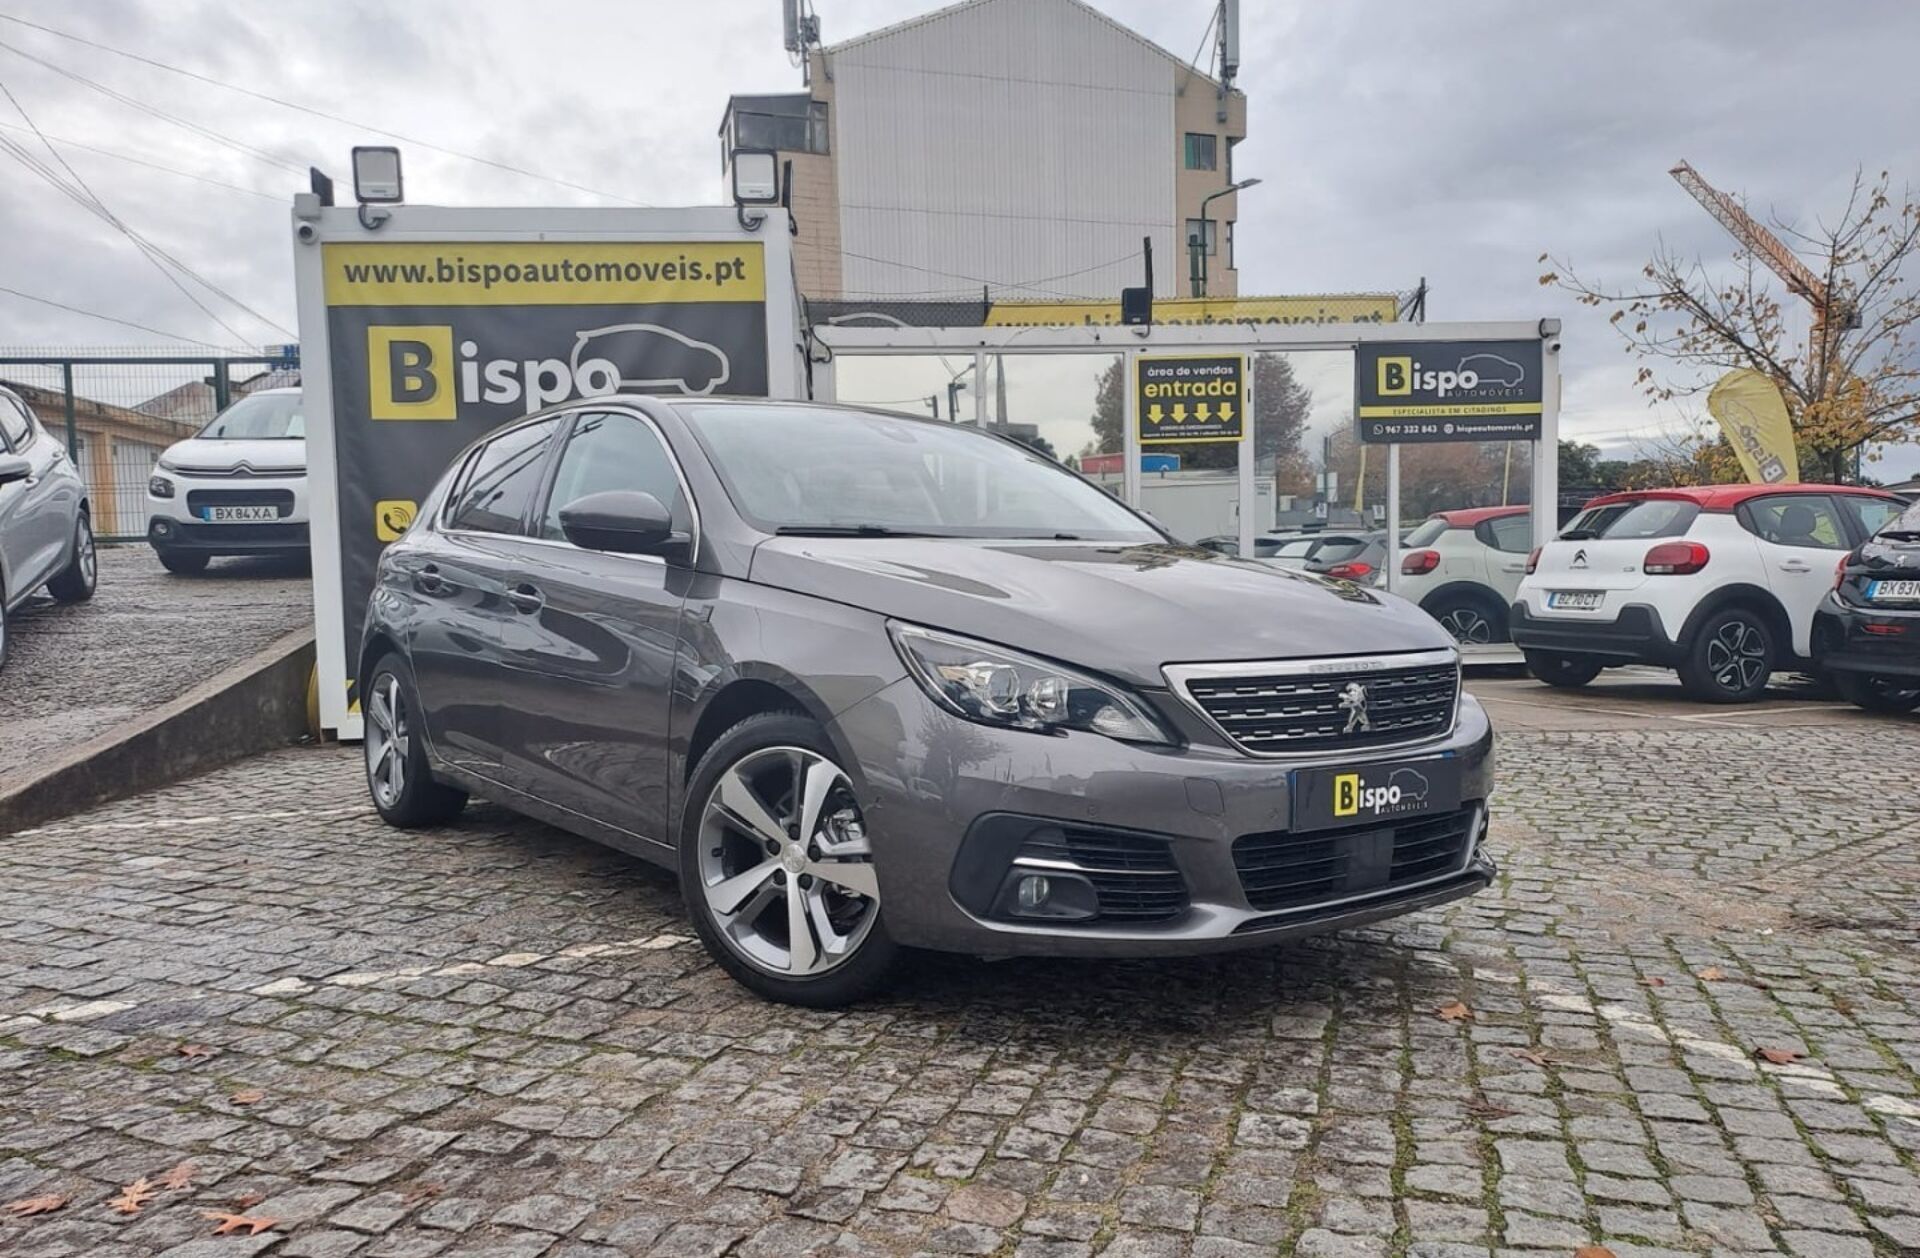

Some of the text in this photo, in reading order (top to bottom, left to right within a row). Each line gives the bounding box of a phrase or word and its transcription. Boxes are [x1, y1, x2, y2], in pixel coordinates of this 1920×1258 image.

[344, 255, 746, 289] www.bispoautomoveis.pt
[388, 340, 621, 415] Bispo
[1144, 378, 1237, 397] entrada
[1147, 365, 1234, 377] área de vendas
[1385, 362, 1479, 397] Bispo
[1393, 408, 1445, 416] ESPECIALISTA
[1448, 407, 1461, 415] EM
[1341, 779, 1401, 815] Bispo
